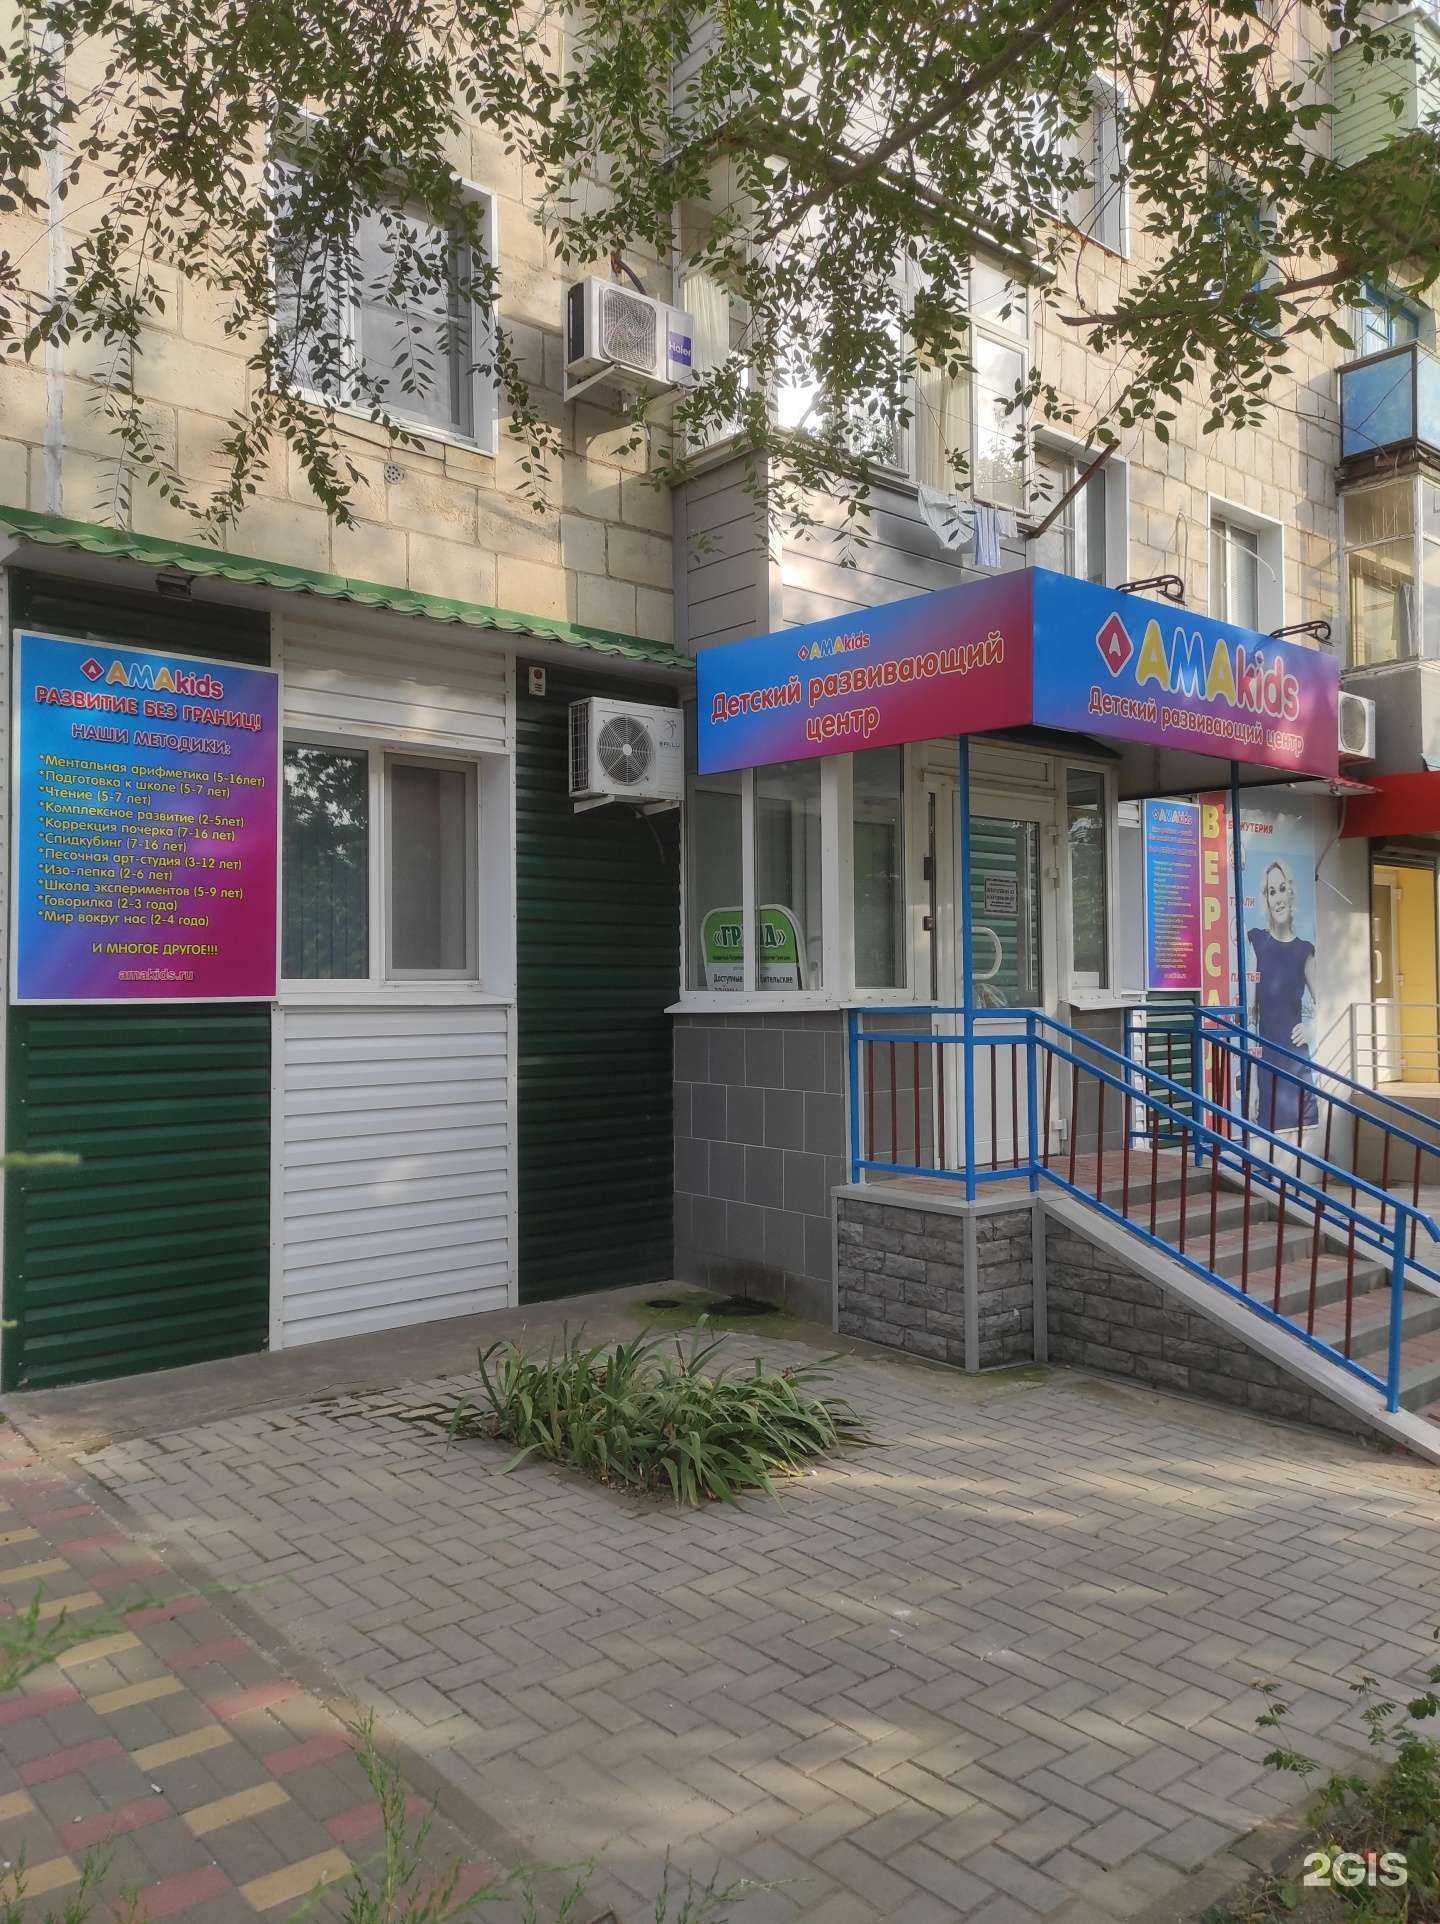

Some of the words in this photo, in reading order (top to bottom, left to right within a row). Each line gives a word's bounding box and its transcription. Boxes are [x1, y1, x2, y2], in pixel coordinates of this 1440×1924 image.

[810, 631, 871, 659] AMAkids
[710, 676, 801, 724] Детский
[808, 631, 1005, 704] развивающий
[1134, 618, 1300, 722] AMAkids
[106, 660, 224, 700] AMAkids
[35, 686, 137, 715] РАЗВИТИЕ
[144, 702, 177, 719] БЕЗ
[183, 706, 262, 731] ГРАНИЦ!
[806, 704, 880, 742] центр
[1088, 685, 1157, 722] Детский
[1160, 704, 1263, 745] развивающий
[1266, 729, 1304, 757] центр
[72, 723, 129, 744] НАШИ
[133, 731, 231, 755] МЕТОДИКИ:
[131, 765, 209, 781] арифметика
[126, 780, 132, 788] к
[136, 781, 176, 793] школе
[207, 786, 230, 799] лет)
[126, 793, 151, 806] лет)
[138, 810, 194, 824] развитие
[121, 825, 173, 837] почерка
[212, 831, 235, 842] лет)
[162, 841, 187, 852] лет)
[113, 854, 181, 868] арт-студия
[219, 859, 242, 871] лет)
[148, 870, 173, 881] лет)
[95, 882, 190, 897] экспериментов
[220, 887, 243, 899] лет)
[147, 899, 177, 912] года)
[78, 913, 120, 926] вокруг
[124, 914, 147, 925] нас
[178, 915, 208, 927] года)
[92, 943, 102, 953] И
[106, 943, 159, 955] МНОГОЕ
[118, 968, 194, 981] amakids.ru
